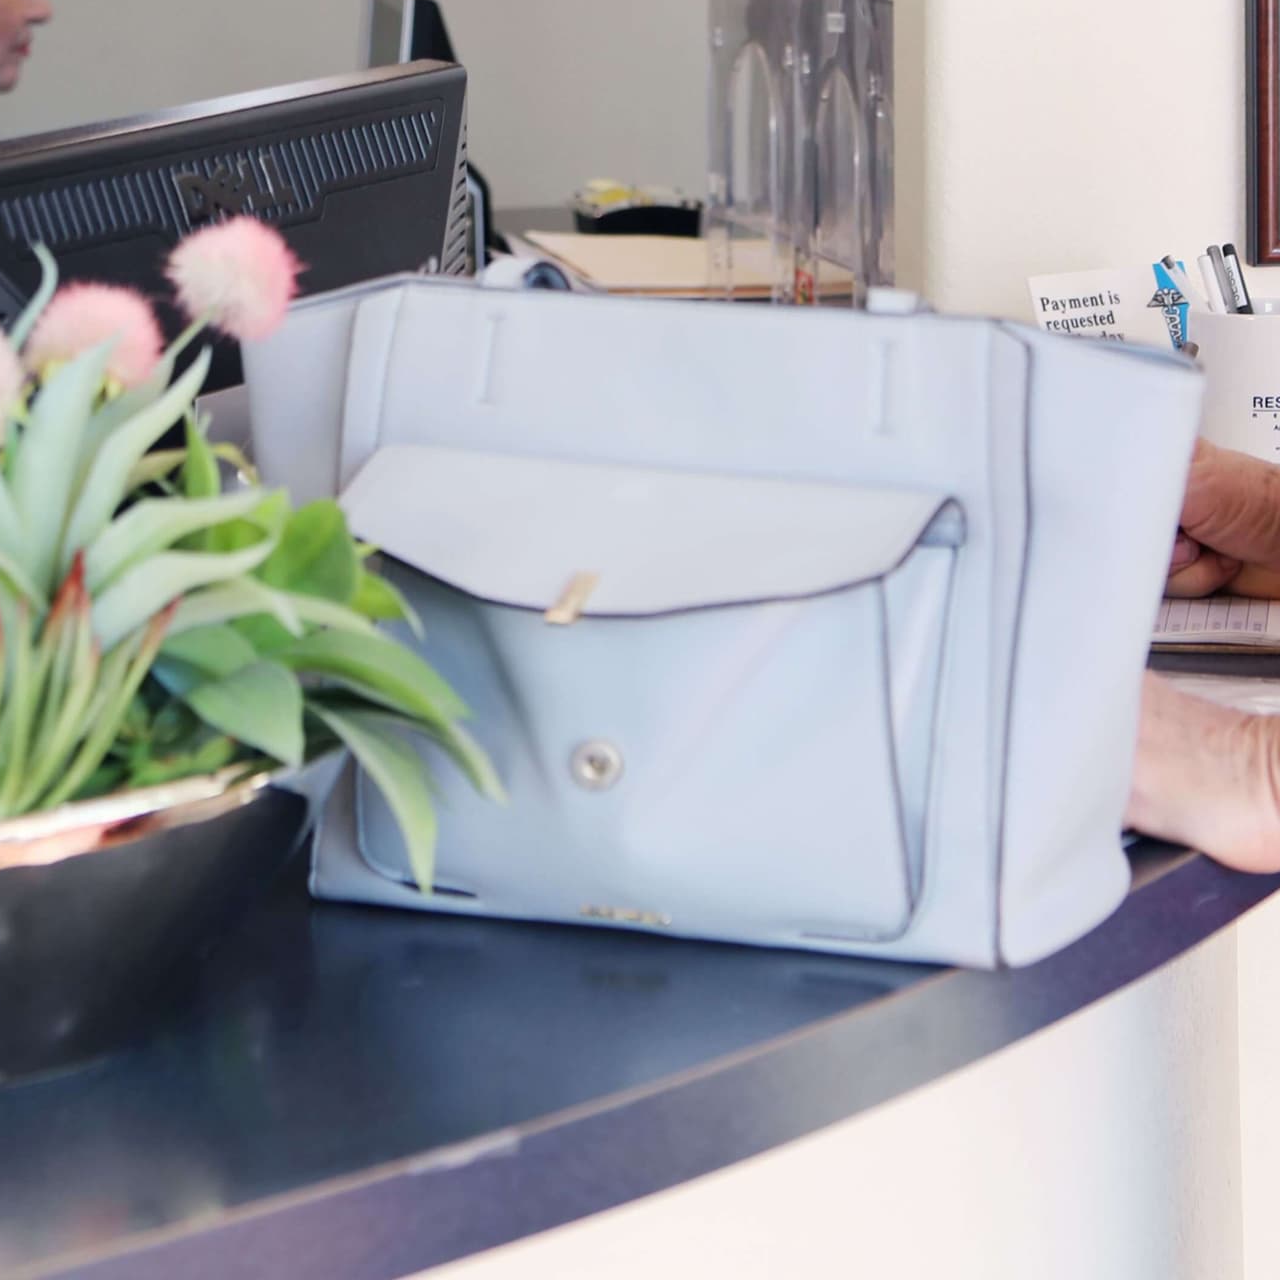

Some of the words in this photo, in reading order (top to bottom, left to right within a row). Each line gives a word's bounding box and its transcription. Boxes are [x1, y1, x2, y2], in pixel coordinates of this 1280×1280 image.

[1040, 293, 1105, 314] Payment
[1107, 290, 1121, 305] is
[1046, 310, 1116, 334] requested
